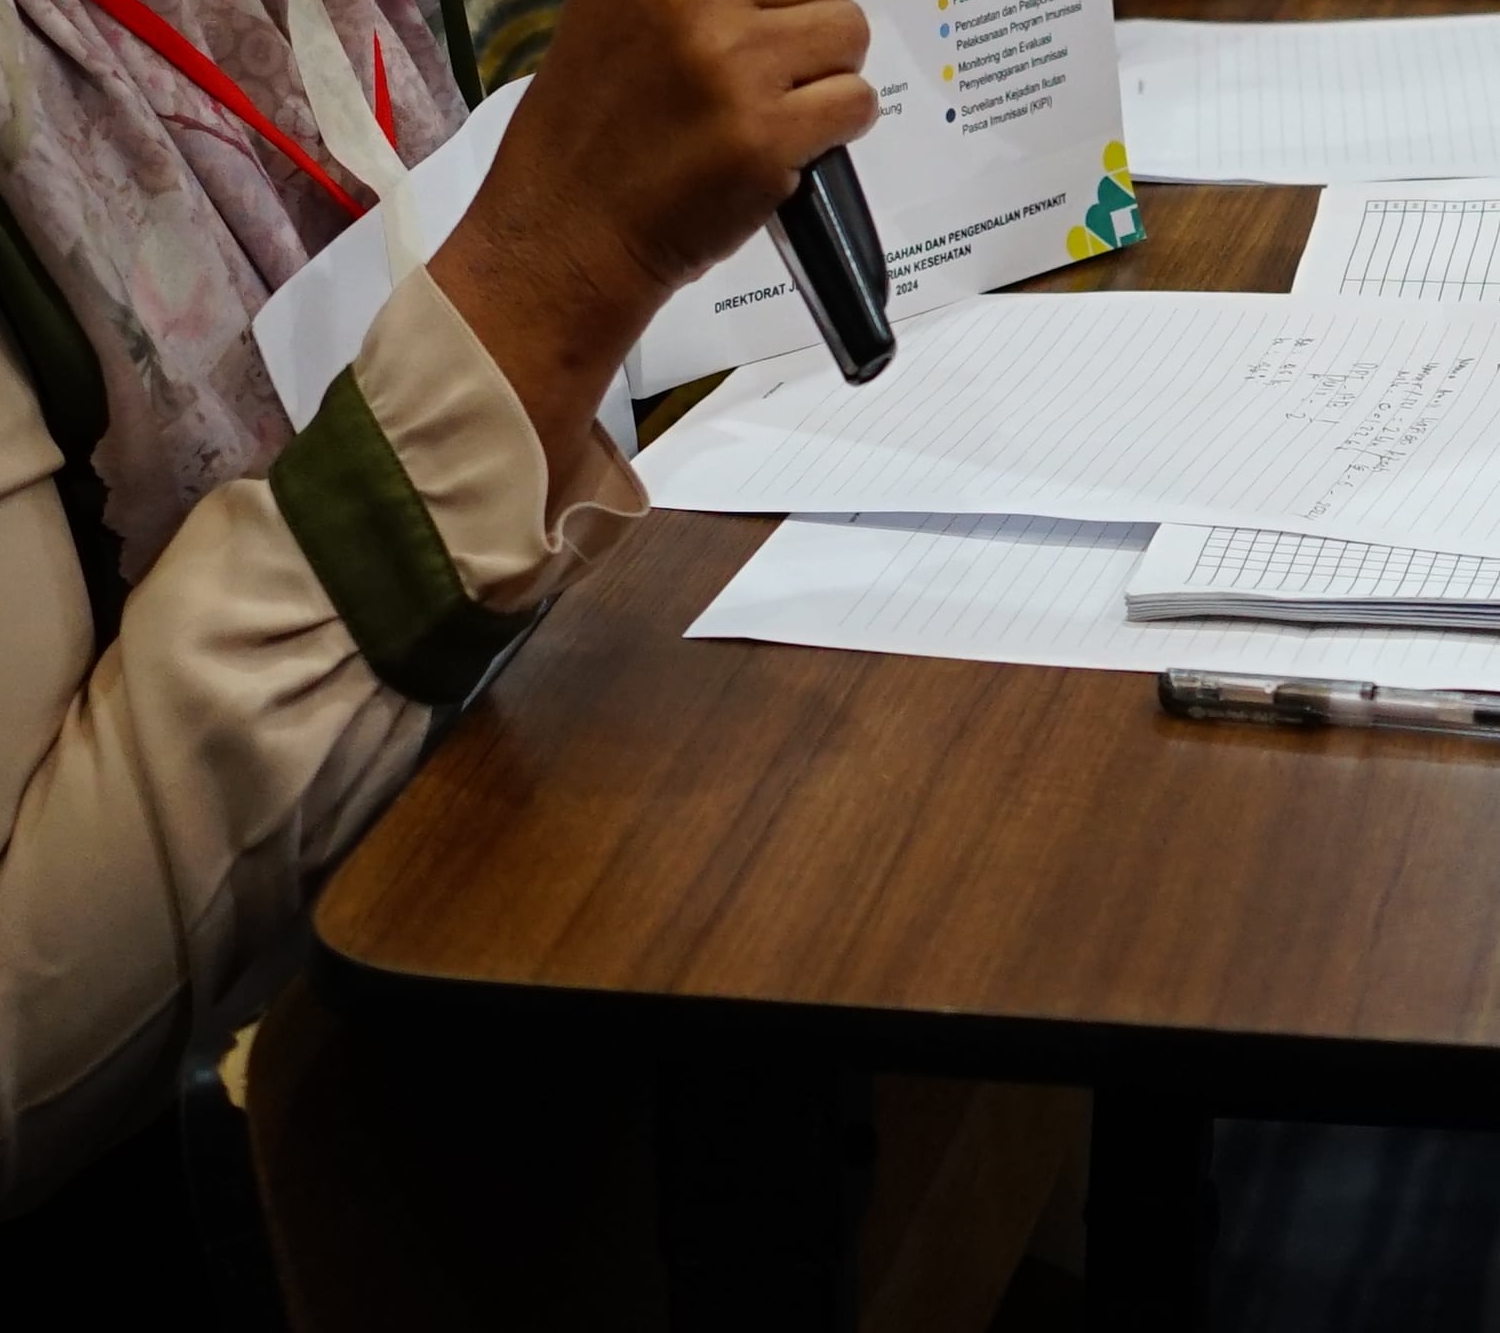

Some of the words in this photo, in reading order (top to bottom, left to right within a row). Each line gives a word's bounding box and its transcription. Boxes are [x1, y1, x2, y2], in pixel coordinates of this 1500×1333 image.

[956, 10, 1000, 31] Pencatatan
[1002, 3, 1017, 17] dan
[957, 27, 1007, 50] Pelaksanaan
[1010, 15, 1043, 32] Program
[1046, 2, 1082, 21] Imunisasi
[959, 51, 1000, 72] Monitoring
[1002, 46, 1017, 58] dan
[1020, 34, 1052, 52] Evaluasi
[960, 61, 1029, 91] Penyelenggaraan
[1032, 48, 1068, 67] Imunisasi
[880, 82, 908, 97] dalam
[1006, 82, 1040, 101] Kejadian
[1042, 74, 1066, 88] Ikutan
[963, 119, 988, 135] Pasca
[991, 106, 1028, 125] Imunisasi
[714, 283, 786, 313] DIREKTORAT
[925, 235, 946, 252] DAN
[948, 209, 1021, 243] PENGENDALIAN
[1022, 193, 1066, 216] PENYAKIT
[914, 244, 972, 272] KESEHATAN
[895, 279, 919, 296] 2024
